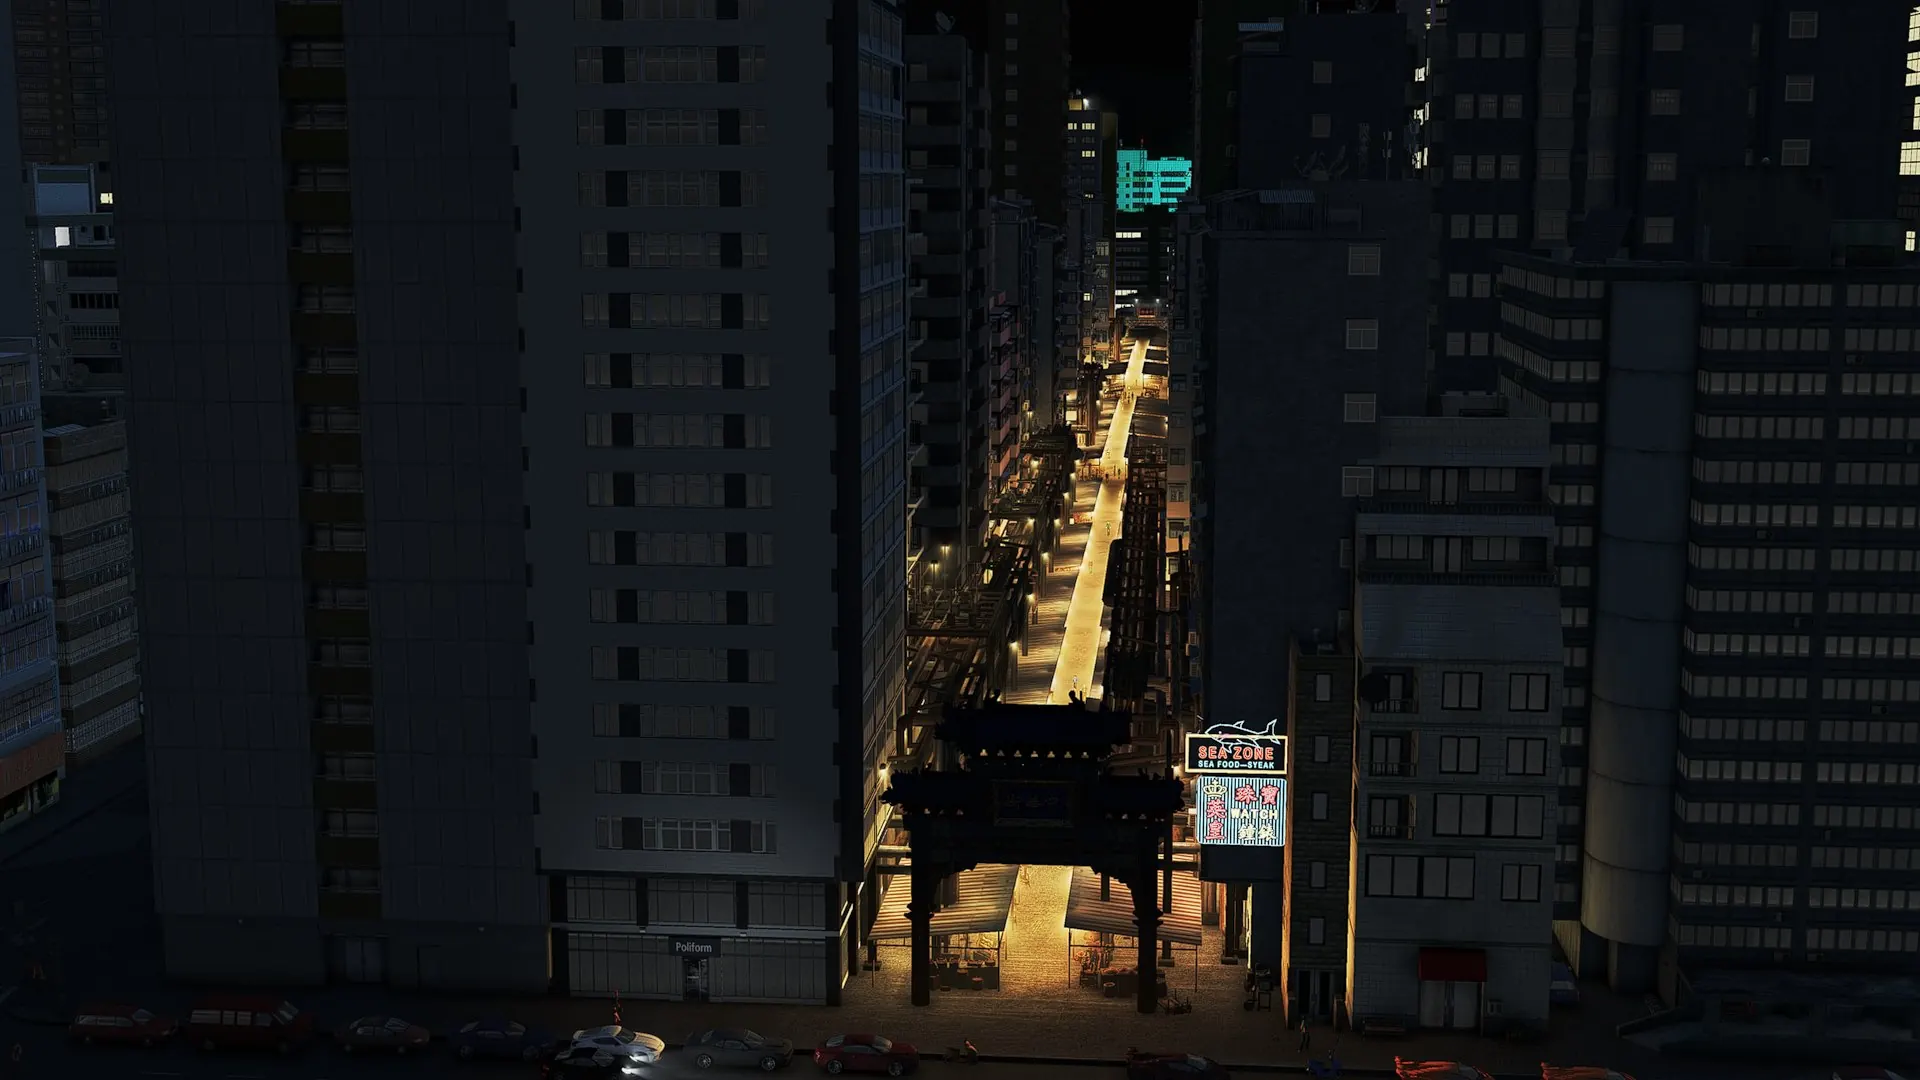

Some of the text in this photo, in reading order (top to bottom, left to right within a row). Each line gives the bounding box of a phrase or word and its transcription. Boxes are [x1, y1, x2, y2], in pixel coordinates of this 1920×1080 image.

[1198, 745, 1274, 760] SEA ZONE
[1198, 760, 1215, 768] SEA
[1205, 799, 1227, 840] 英皇
[1231, 808, 1278, 821] WATCH
[675, 941, 713, 953] Poliform
